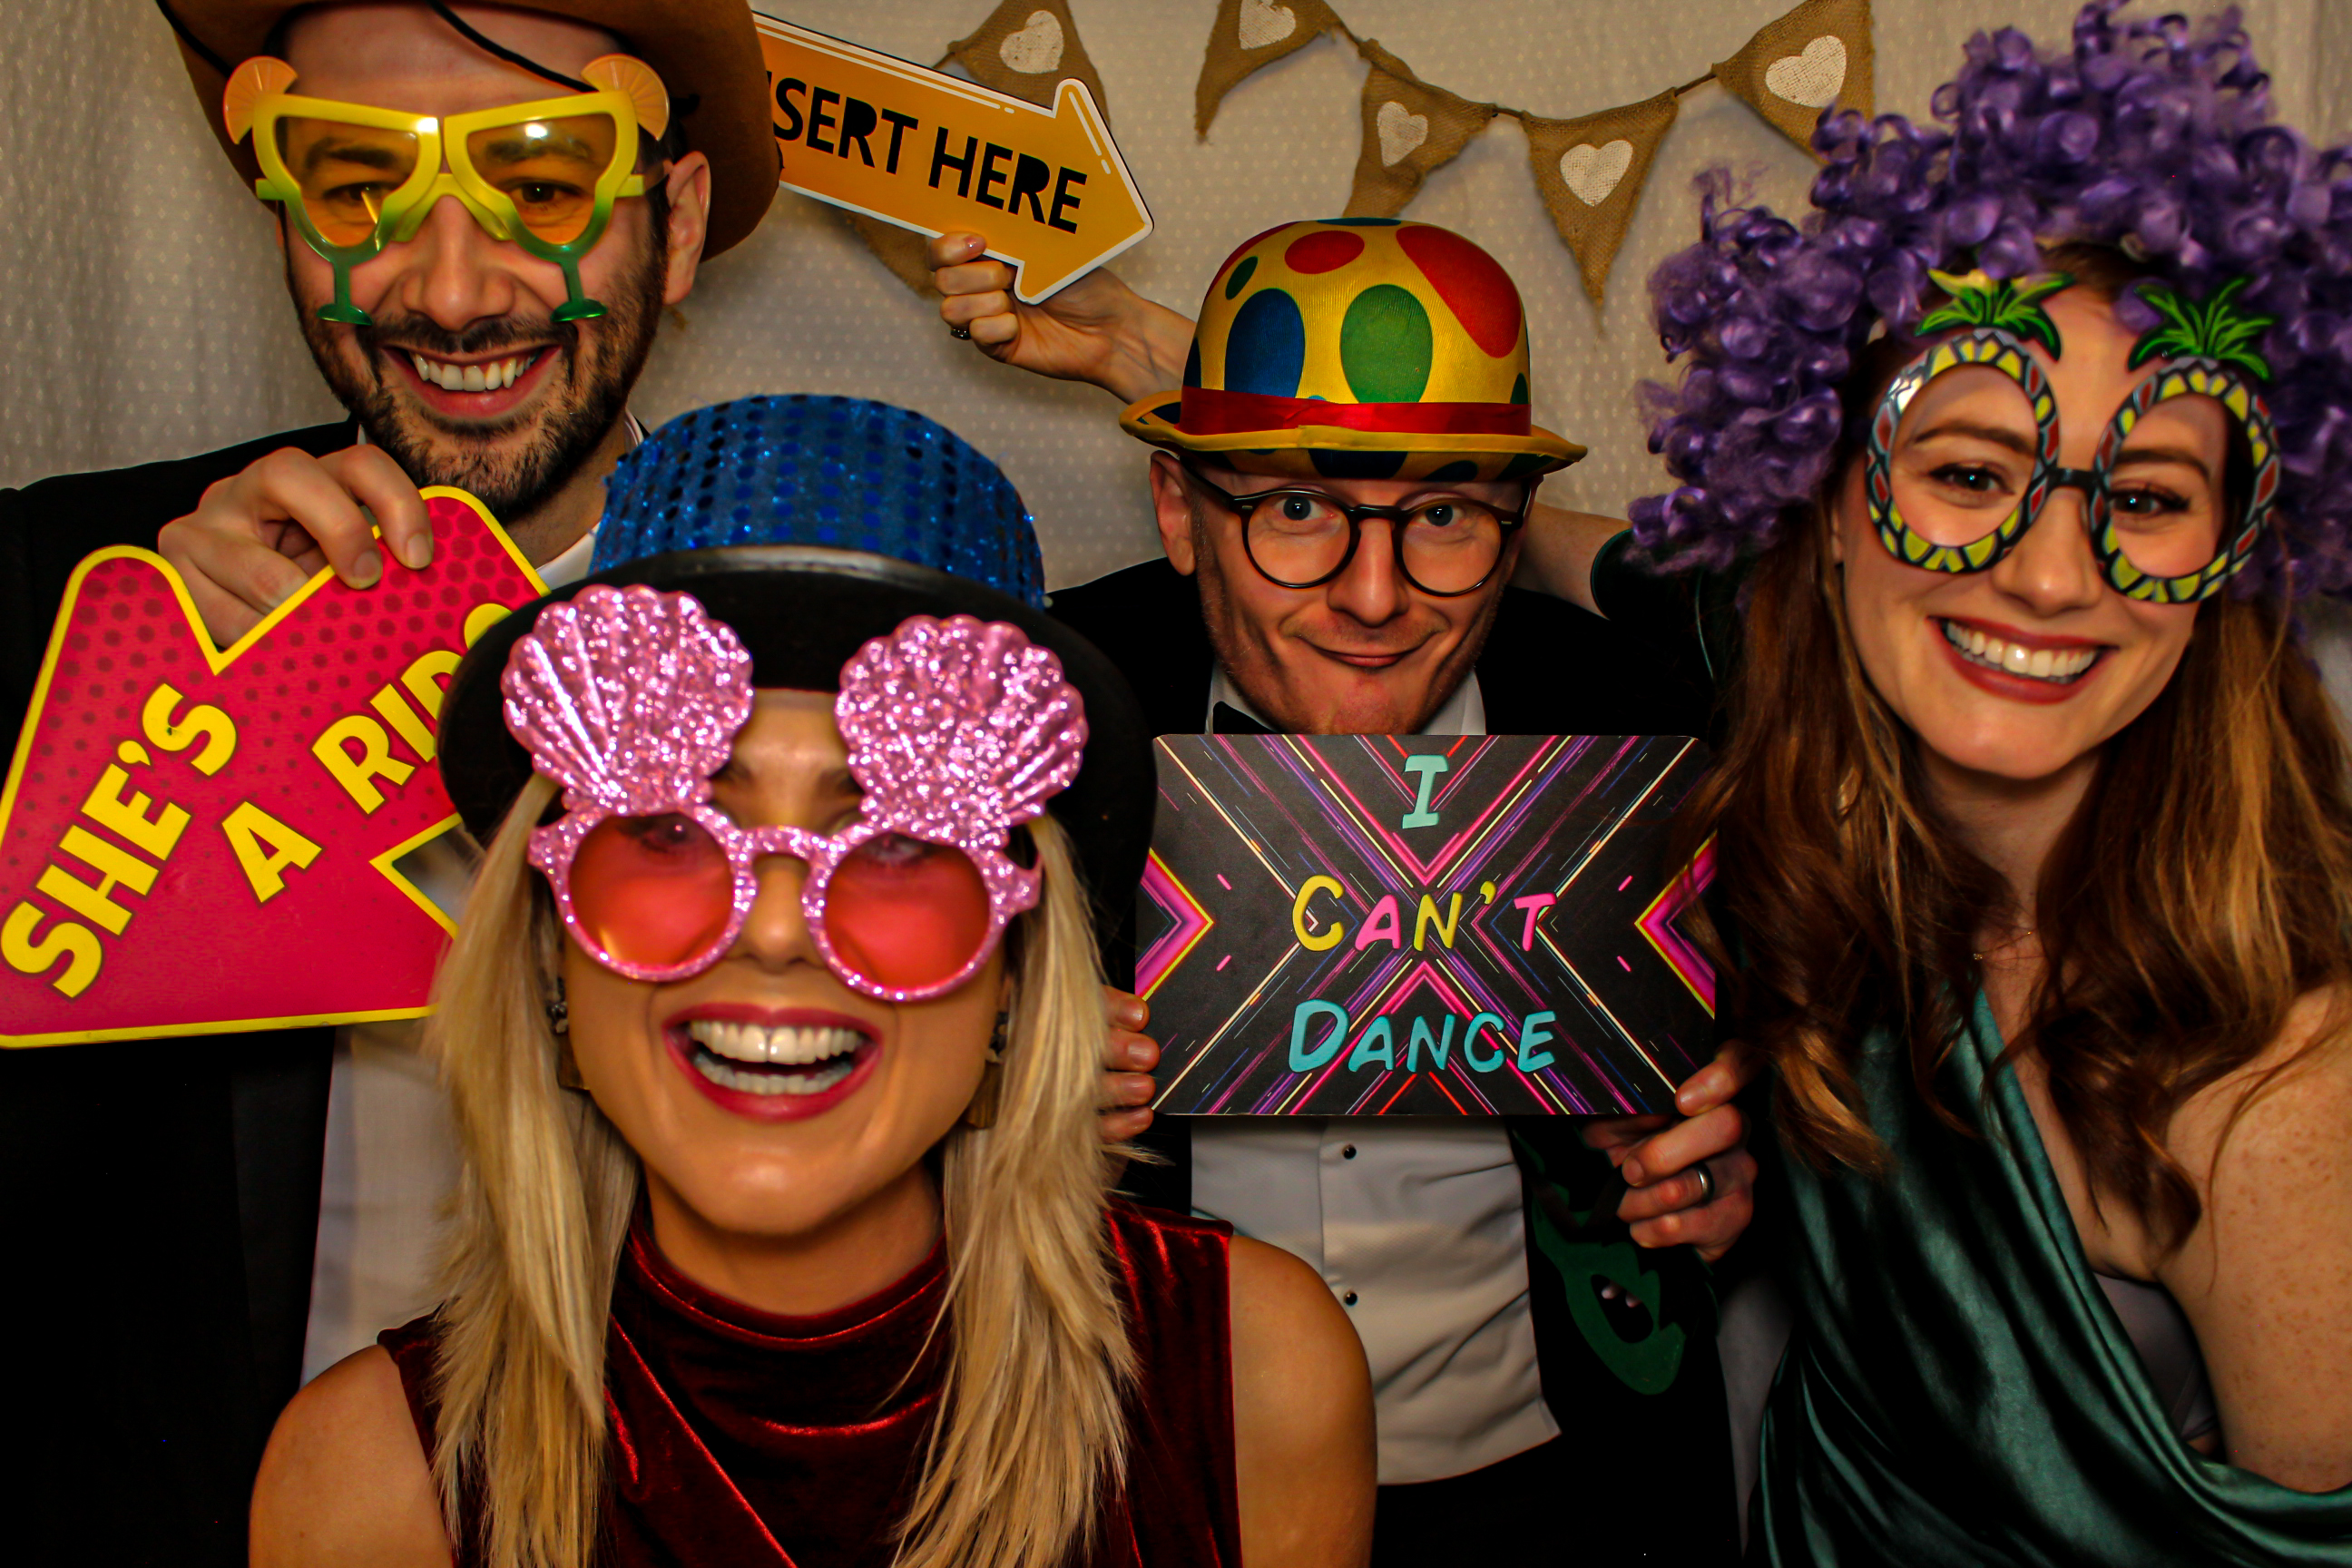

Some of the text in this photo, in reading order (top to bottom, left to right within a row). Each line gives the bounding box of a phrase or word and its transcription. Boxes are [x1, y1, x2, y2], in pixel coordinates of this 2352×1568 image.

[767, 71, 1088, 235] SERT HERE
[1402, 754, 1449, 829] I
[0, 683, 238, 999] SHE'S
[221, 800, 323, 903] A
[1291, 875, 1557, 952] CAN'T
[1289, 998, 1557, 1073] DANCE
